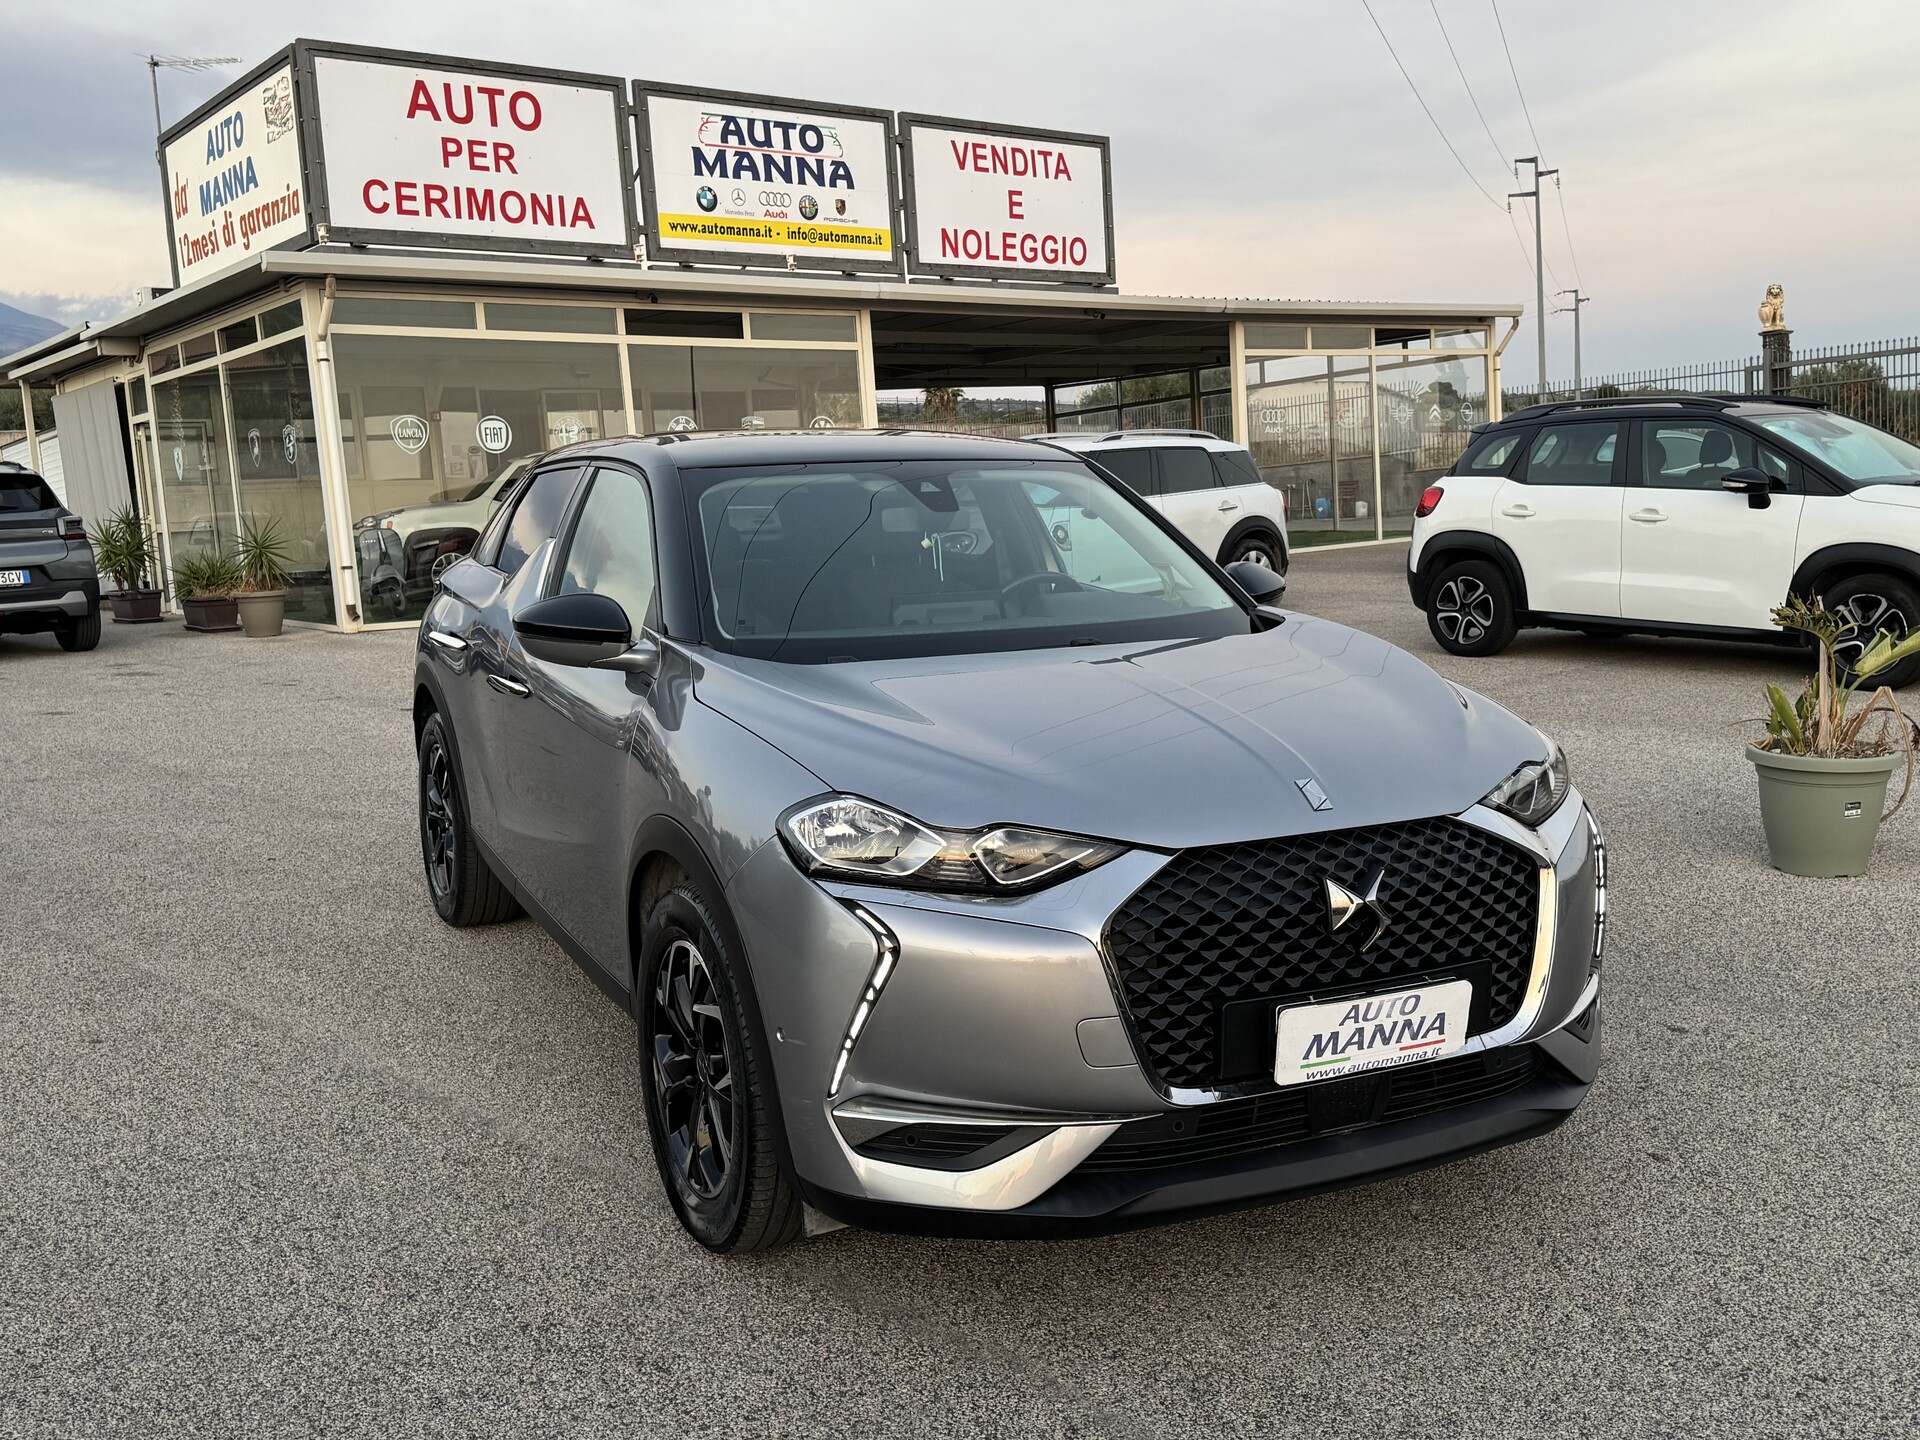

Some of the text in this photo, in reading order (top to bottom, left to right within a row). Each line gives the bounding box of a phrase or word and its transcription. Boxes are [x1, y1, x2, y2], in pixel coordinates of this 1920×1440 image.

[406, 79, 542, 132] AUTO
[206, 111, 244, 165] AUTO
[720, 115, 825, 154] AUTO
[441, 137, 519, 175] PER
[691, 146, 856, 190] MANNA
[950, 140, 1072, 182] VENDITA
[199, 155, 259, 217] MANNA
[362, 179, 596, 230] CERIMONIA
[1008, 190, 1024, 220] E
[222, 210, 236, 248] di
[239, 183, 301, 251] garanzia
[668, 221, 773, 238] www.automanna.it
[787, 226, 883, 246] info@automanna.it
[763, 209, 788, 219] Audi
[941, 227, 1088, 266] NOLEGGIO
[398, 427, 422, 439] LANCIA
[484, 427, 503, 443] FIAT
[1338, 994, 1421, 1027] AUTO
[1302, 1012, 1447, 1060] MANNA
[1306, 1047, 1442, 1080] www.automanna.it
